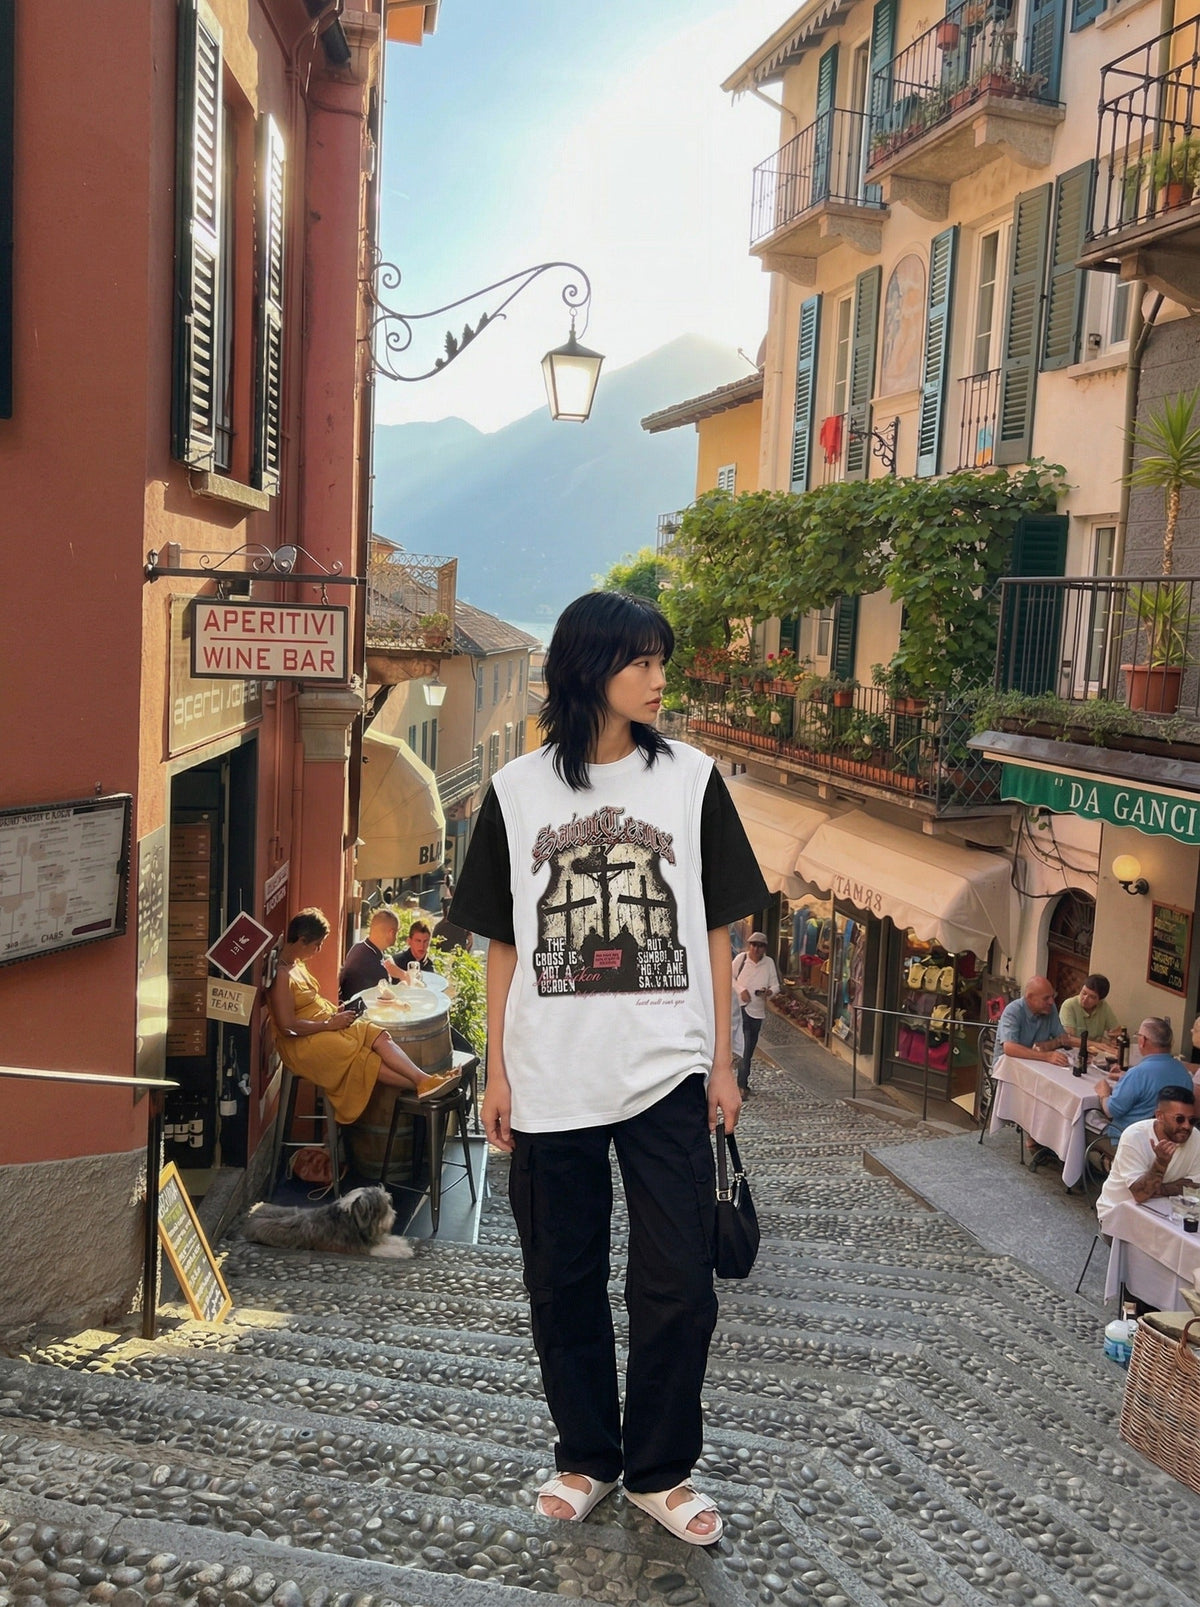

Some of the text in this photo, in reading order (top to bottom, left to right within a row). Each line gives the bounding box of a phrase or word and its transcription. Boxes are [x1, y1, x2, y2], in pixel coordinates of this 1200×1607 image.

[203, 609, 335, 636] APERITIVI
[203, 646, 335, 672] WINE BAR
[547, 937, 567, 952] THE
[674, 949, 685, 963] OF
[211, 998, 239, 1013] TEARS
